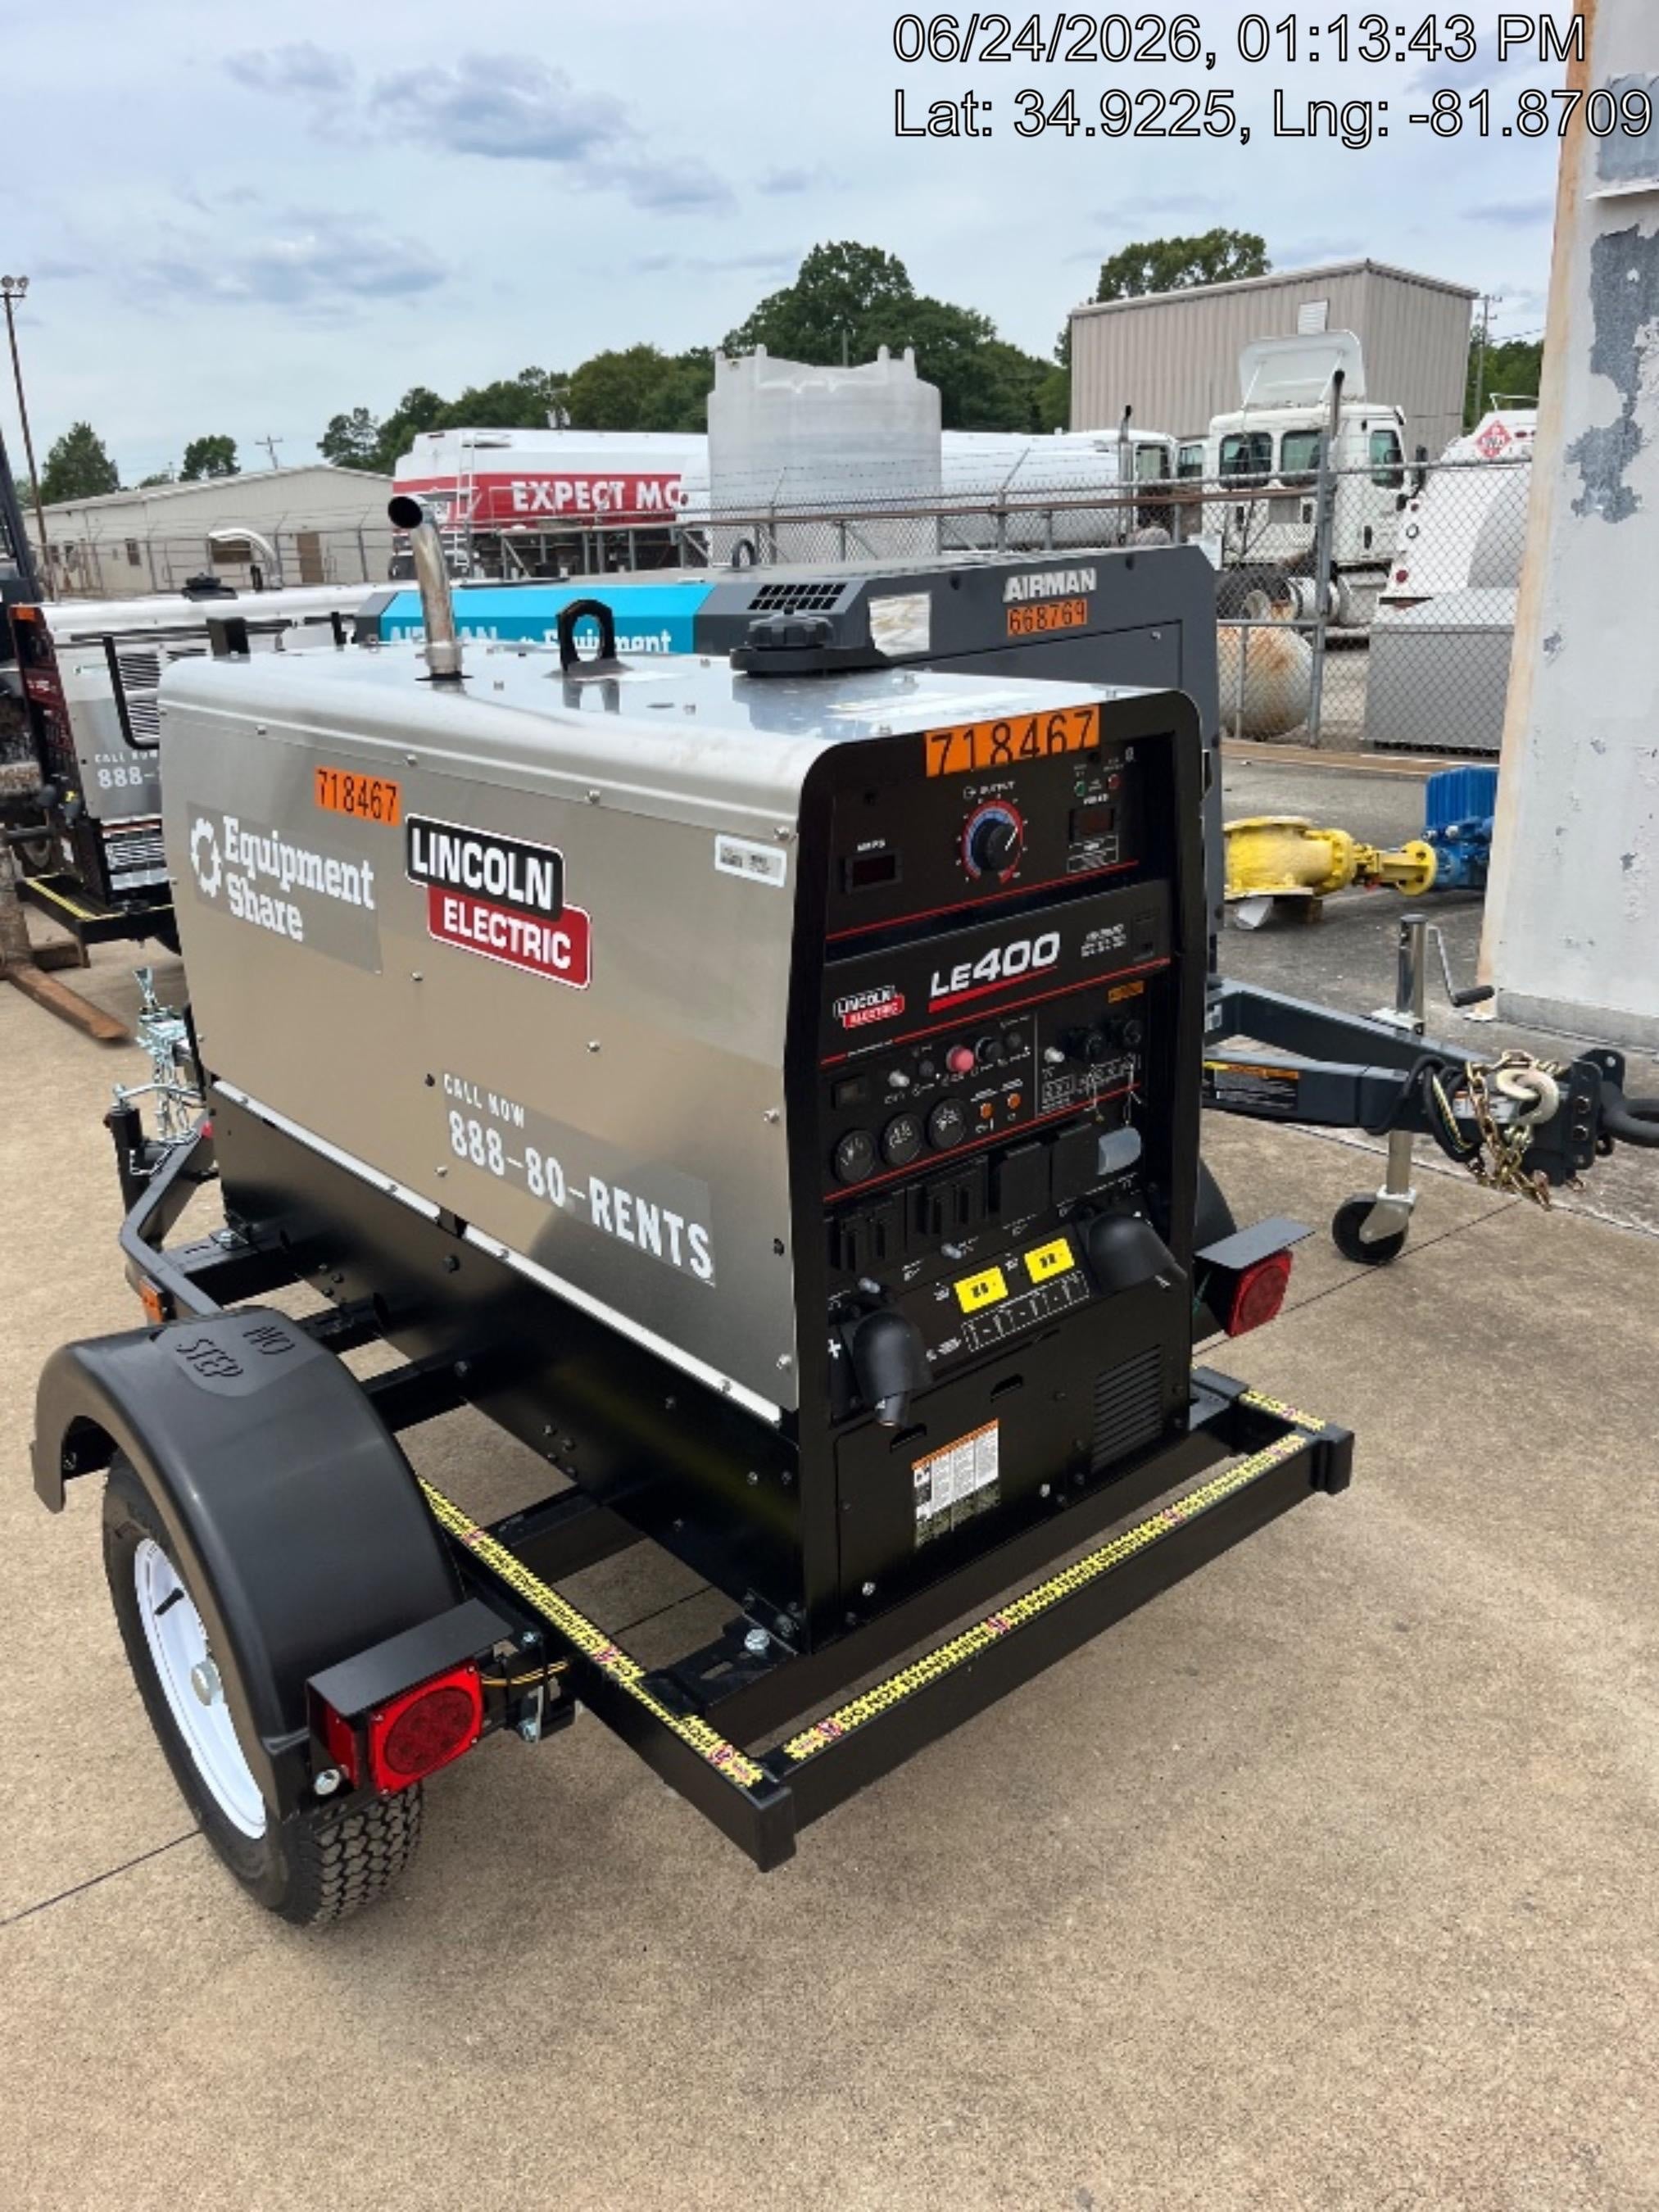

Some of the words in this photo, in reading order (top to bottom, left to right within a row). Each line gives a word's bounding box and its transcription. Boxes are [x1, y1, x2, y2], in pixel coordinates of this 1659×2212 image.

[512, 480, 625, 511] EXPECT
[1002, 567, 1096, 602] AIRMAN
[1009, 601, 1085, 634] 668769
[931, 709, 1094, 776] 718467
[317, 768, 397, 822] 718467
[223, 816, 375, 910] Equipment
[412, 827, 554, 911] LINCOLN
[224, 876, 304, 942] Share
[443, 897, 572, 970] ELECTRIC
[931, 931, 1061, 998] LE400
[443, 1072, 483, 1109] CALL
[488, 1092, 525, 1129] NOW
[449, 1110, 714, 1280] 888-80-RENTS
[176, 1339, 244, 1377] STEP
